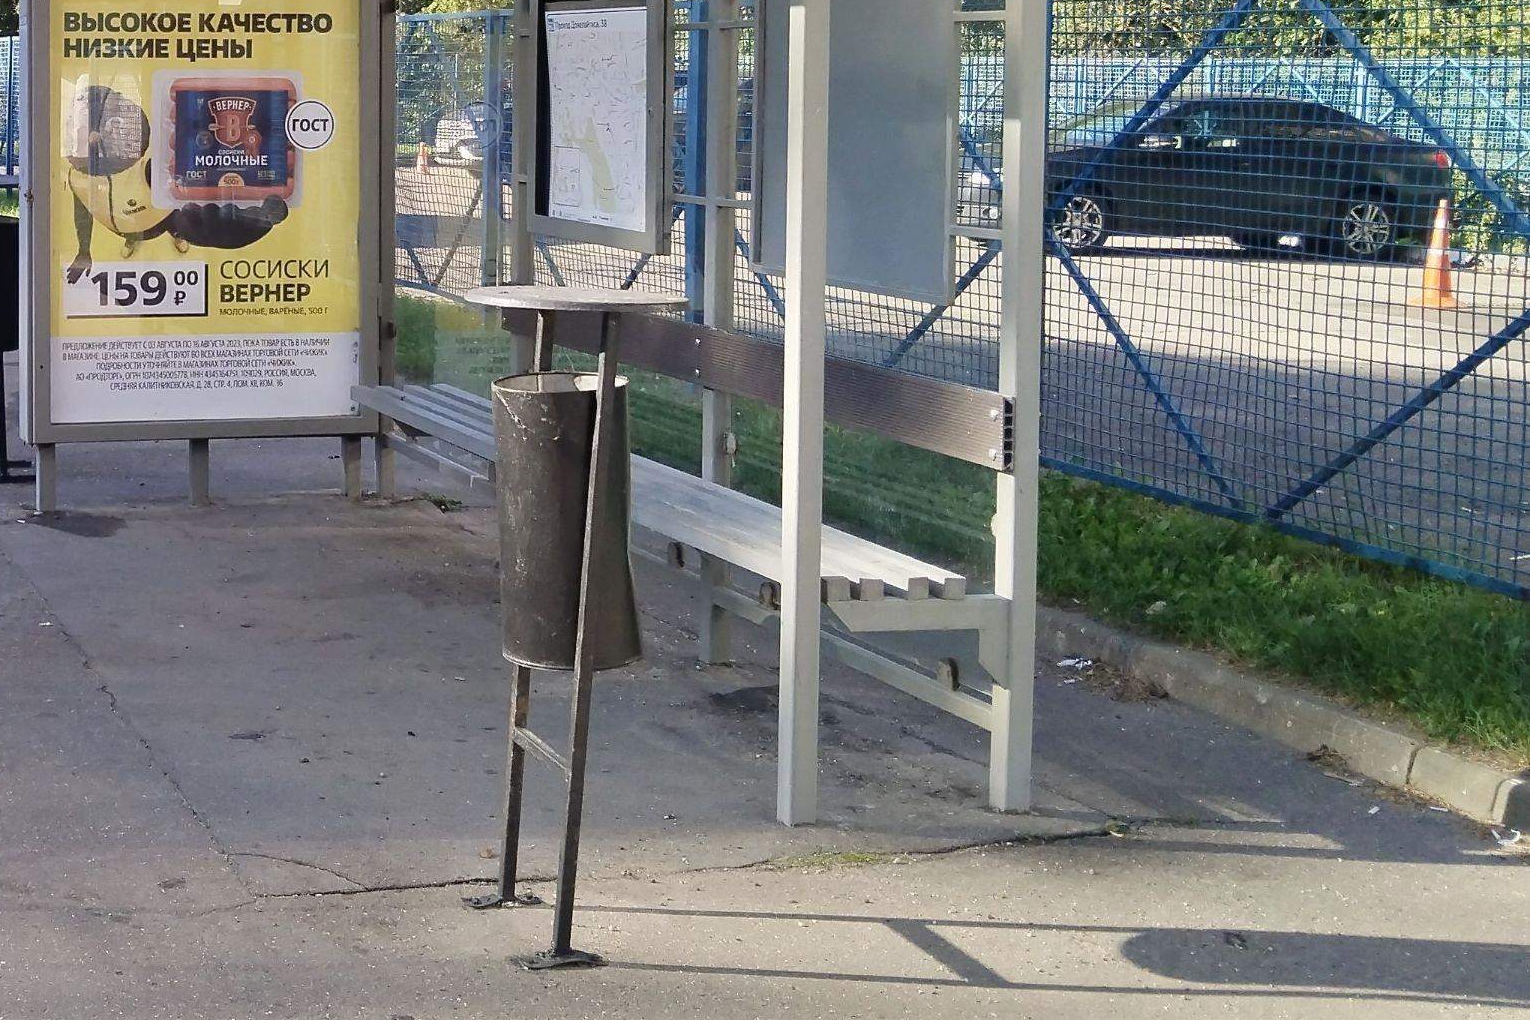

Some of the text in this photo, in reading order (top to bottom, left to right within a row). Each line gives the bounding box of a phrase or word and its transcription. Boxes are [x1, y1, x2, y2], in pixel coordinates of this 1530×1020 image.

[64, 12, 333, 33] ВЫСОКОЕ КАЧЕСТВО
[64, 38, 253, 62] НИЗКИЕ ЦЕНЫ
[215, 100, 250, 111] ВЕРНЕР
[291, 118, 330, 132] ГОСТ
[195, 155, 269, 167] МОЛОЧНЫЕ
[186, 170, 208, 179] ГОСТ
[220, 260, 329, 280] СОСИСКИ
[90, 270, 199, 307] 159 00
[220, 283, 311, 303] ВЕРНЕР
[219, 308, 268, 317] МОЛОЧНЫЕ,
[308, 307, 323, 315] 500
[62, 341, 108, 351] ПРЕДЛОЖЕНИЕ
[108, 340, 142, 350] ДЕЙСТВУЕТ
[157, 340, 183, 349] АВГУСТА
[184, 340, 191, 349] ПО
[200, 340, 225, 348] АВГУСТА
[243, 339, 259, 348] ПОКА
[261, 339, 280, 347] ТОВАР
[281, 339, 295, 347] ЕСТЬ
[301, 338, 330, 347] НАЛИЧИИ
[101, 351, 119, 361] ЦЕНЫ
[120, 351, 128, 360] НА
[130, 351, 154, 360] ТОВАРЫ
[154, 350, 190, 360] ДЕЙСТВУЮТ
[201, 350, 215, 358] ВСЕХ
[216, 349, 251, 358] МАГАЗИНАХ
[253, 348, 283, 357] ТОРГОВОЙ
[284, 348, 299, 357] СЕТИ
[96, 362, 142, 371] ПОДРОБНОСТИ
[183, 360, 218, 369] МАГАЗИНАХ
[220, 359, 251, 368] ТОРГОВОЙ
[251, 359, 266, 368] СЕТИ
